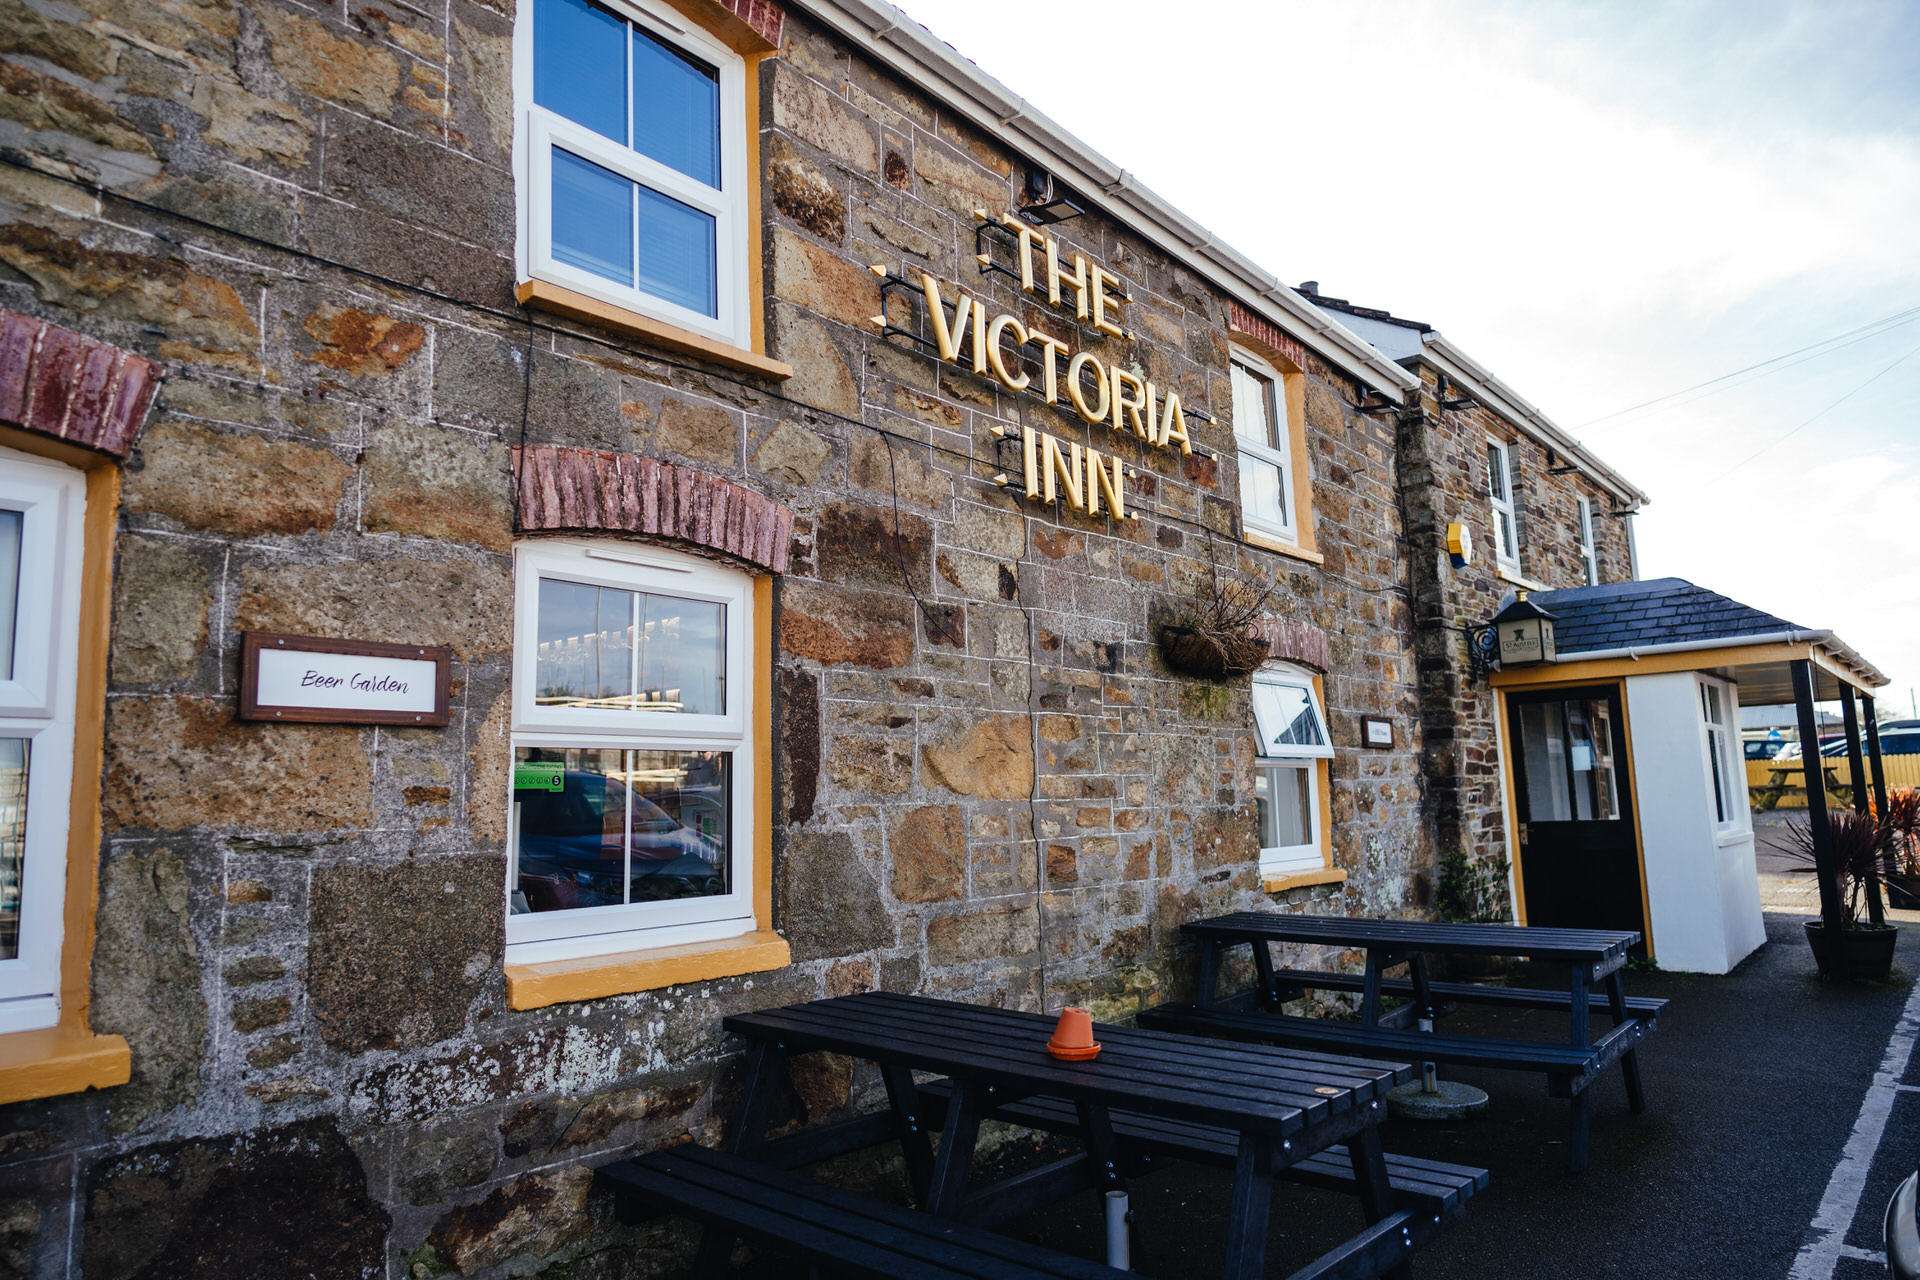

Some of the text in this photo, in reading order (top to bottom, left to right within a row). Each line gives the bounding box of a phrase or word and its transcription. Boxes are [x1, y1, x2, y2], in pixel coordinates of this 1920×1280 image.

[1001, 212, 1123, 339] THE
[920, 273, 1192, 458] VICTORIA
[1022, 425, 1124, 523] INN
[301, 670, 409, 694] Beer Garden
[553, 776, 559, 785] 5
